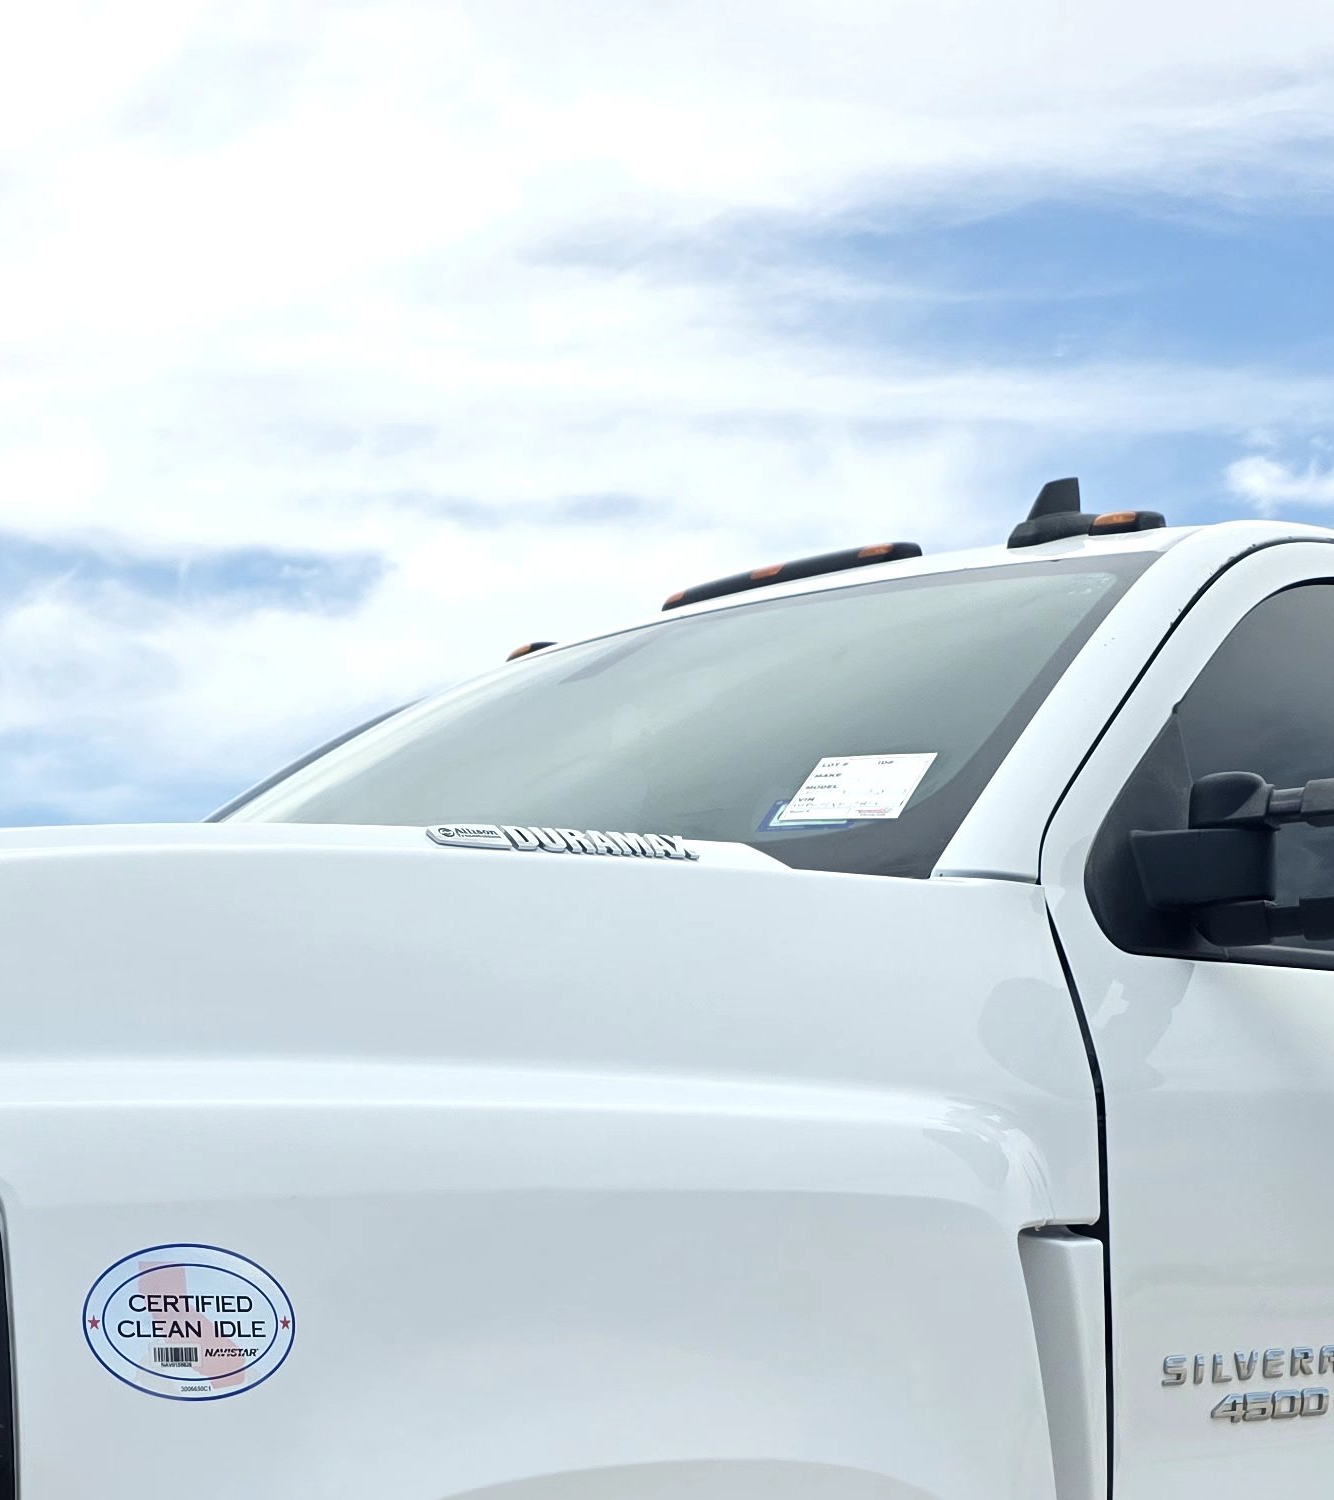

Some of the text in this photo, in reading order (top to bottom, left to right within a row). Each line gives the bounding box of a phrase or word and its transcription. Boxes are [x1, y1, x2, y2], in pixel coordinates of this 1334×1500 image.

[454, 827, 499, 836] Allison
[501, 825, 700, 859] DURAMAX
[128, 1294, 253, 1313] CERTIFIED
[117, 1320, 266, 1338] CLEAN IDLE
[204, 1348, 257, 1357] NAVISTAR
[1210, 1387, 1329, 1423] 4500
